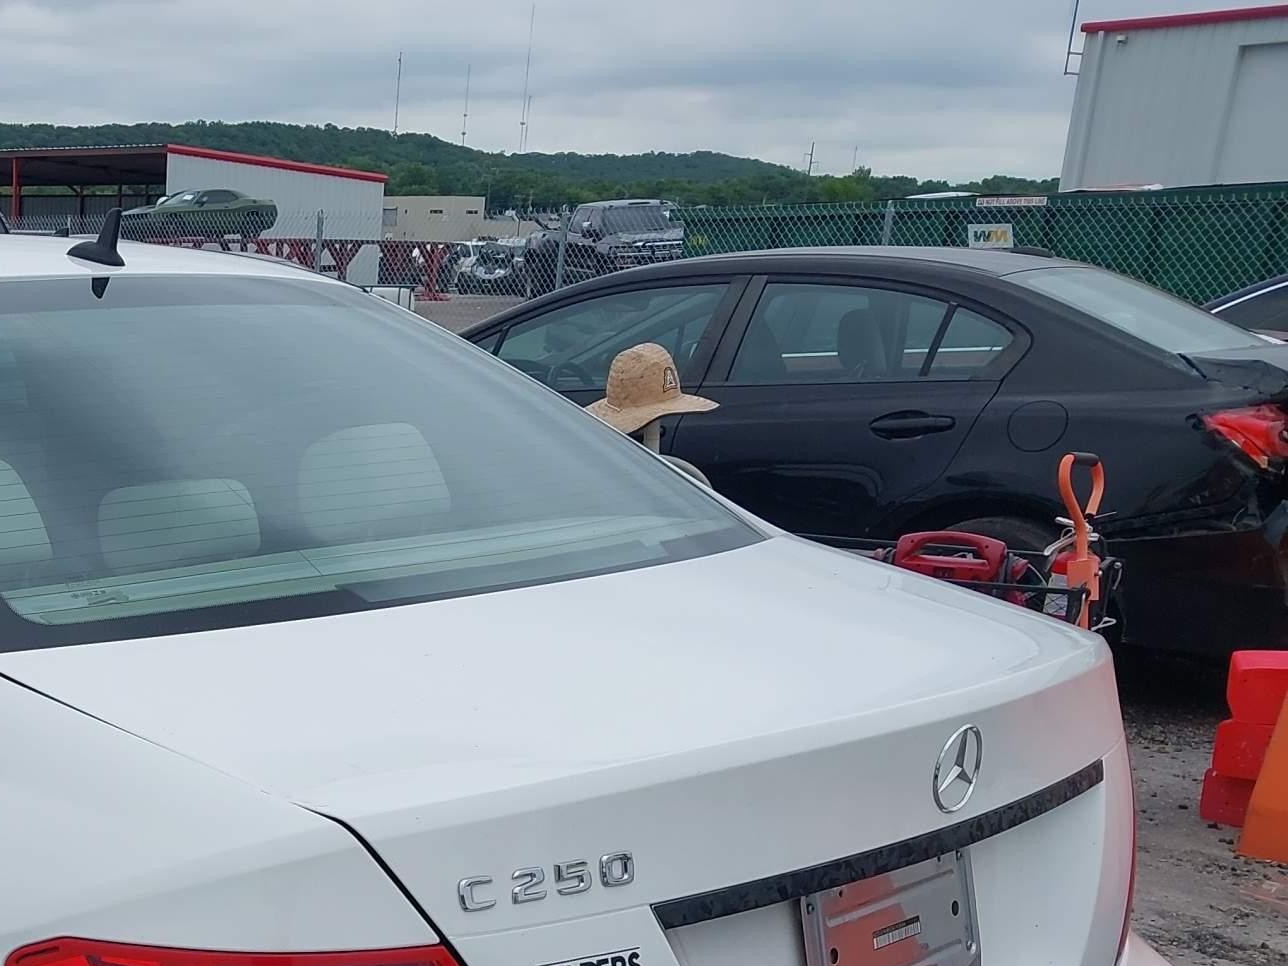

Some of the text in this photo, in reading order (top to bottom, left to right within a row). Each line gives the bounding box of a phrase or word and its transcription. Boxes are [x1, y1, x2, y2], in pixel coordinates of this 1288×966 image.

[973, 230, 1007, 243] WM
[457, 850, 635, 912] C 250
